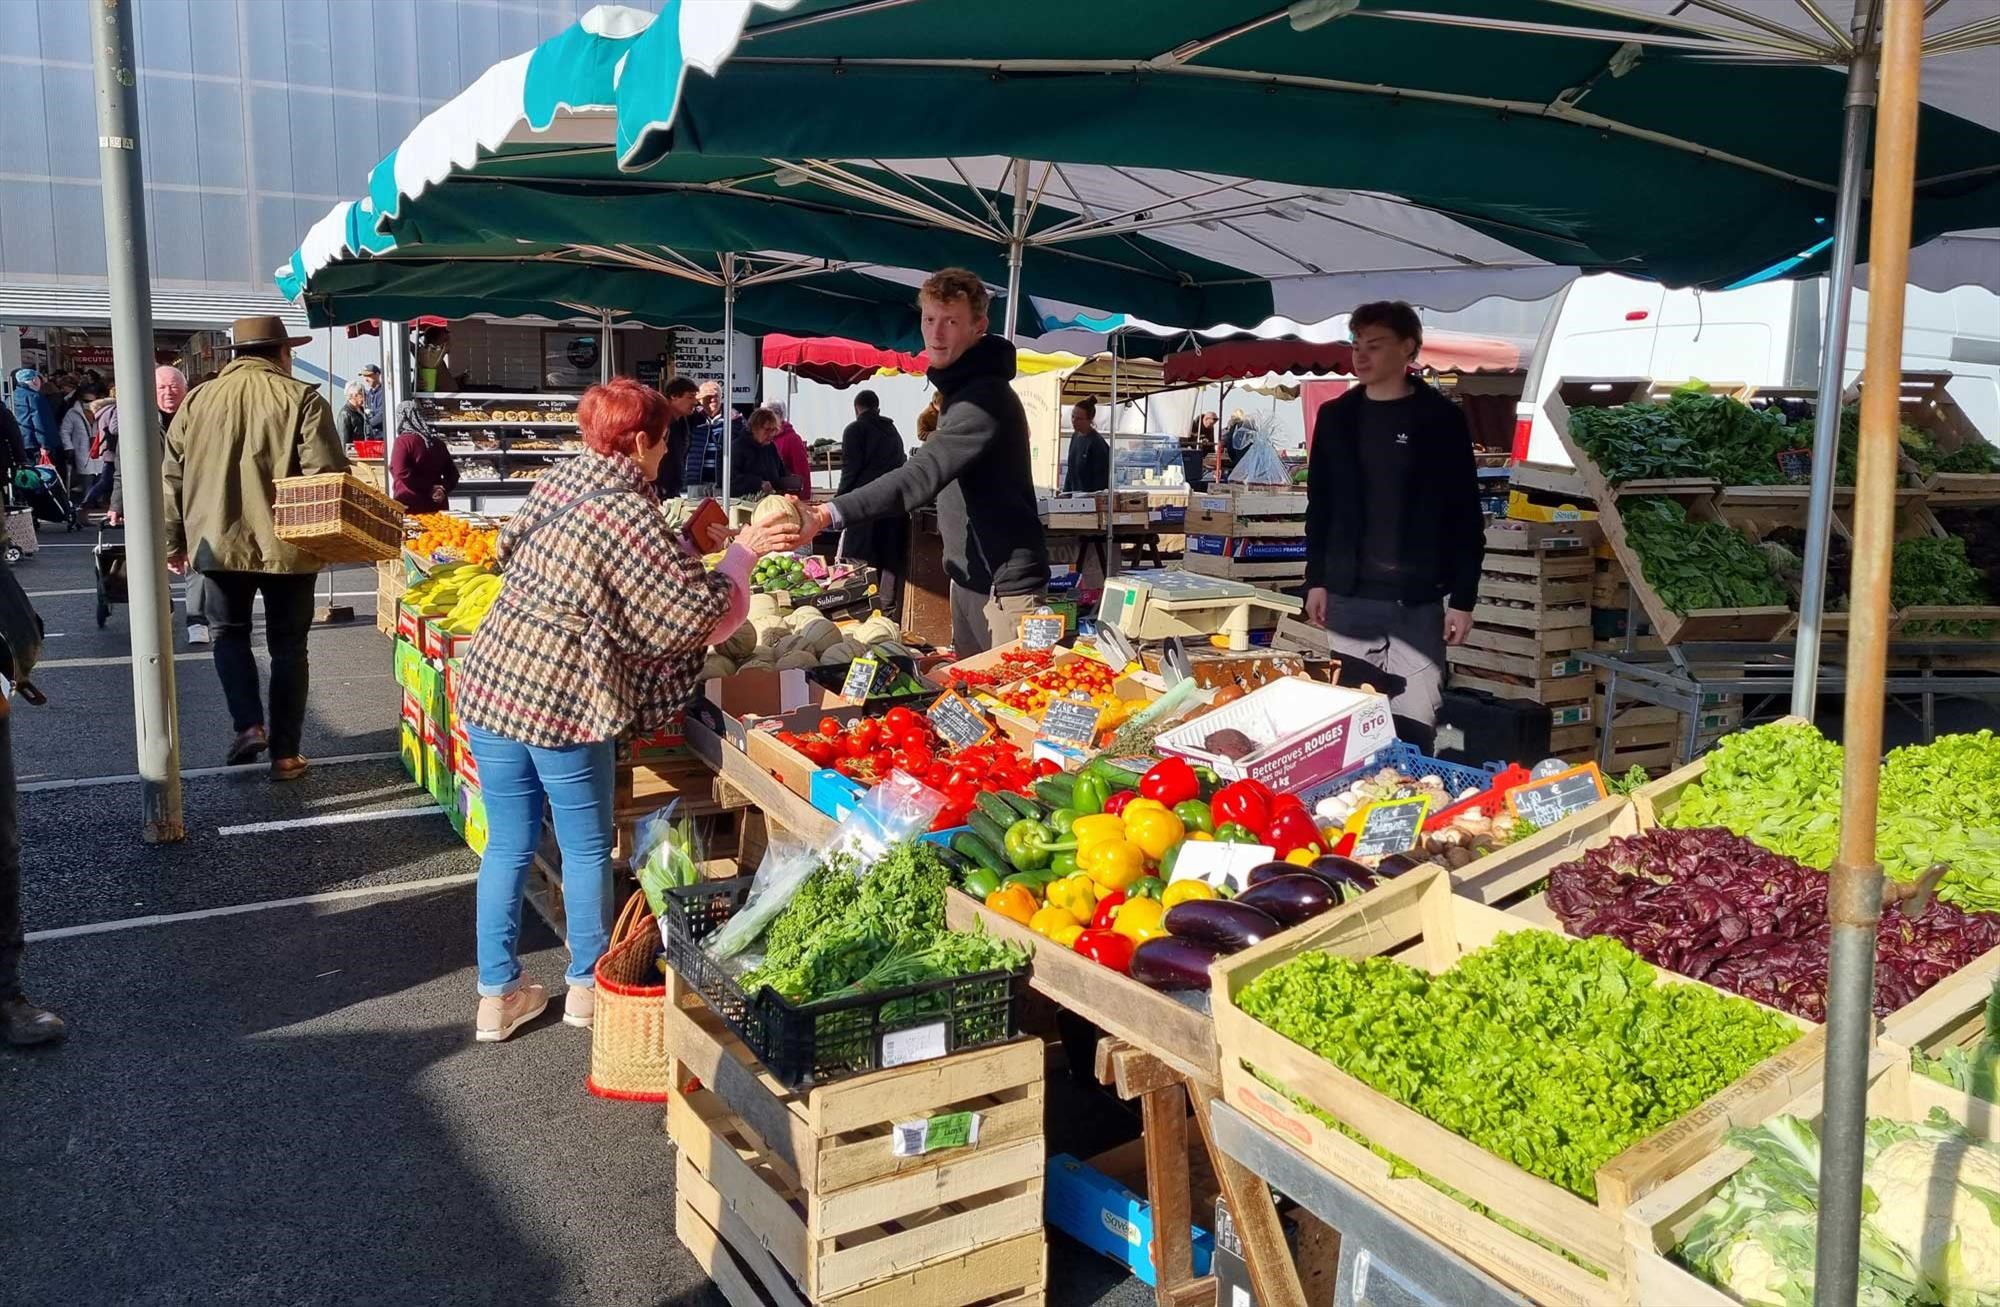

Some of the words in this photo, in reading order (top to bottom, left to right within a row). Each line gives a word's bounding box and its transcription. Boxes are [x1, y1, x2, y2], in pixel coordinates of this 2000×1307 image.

[816, 594, 844, 607] Sublime
[1361, 716, 1386, 734] BTG
[1252, 747, 1303, 779] Betteraves
[1304, 724, 1343, 754] ROUGES
[1279, 775, 1290, 787] kg
